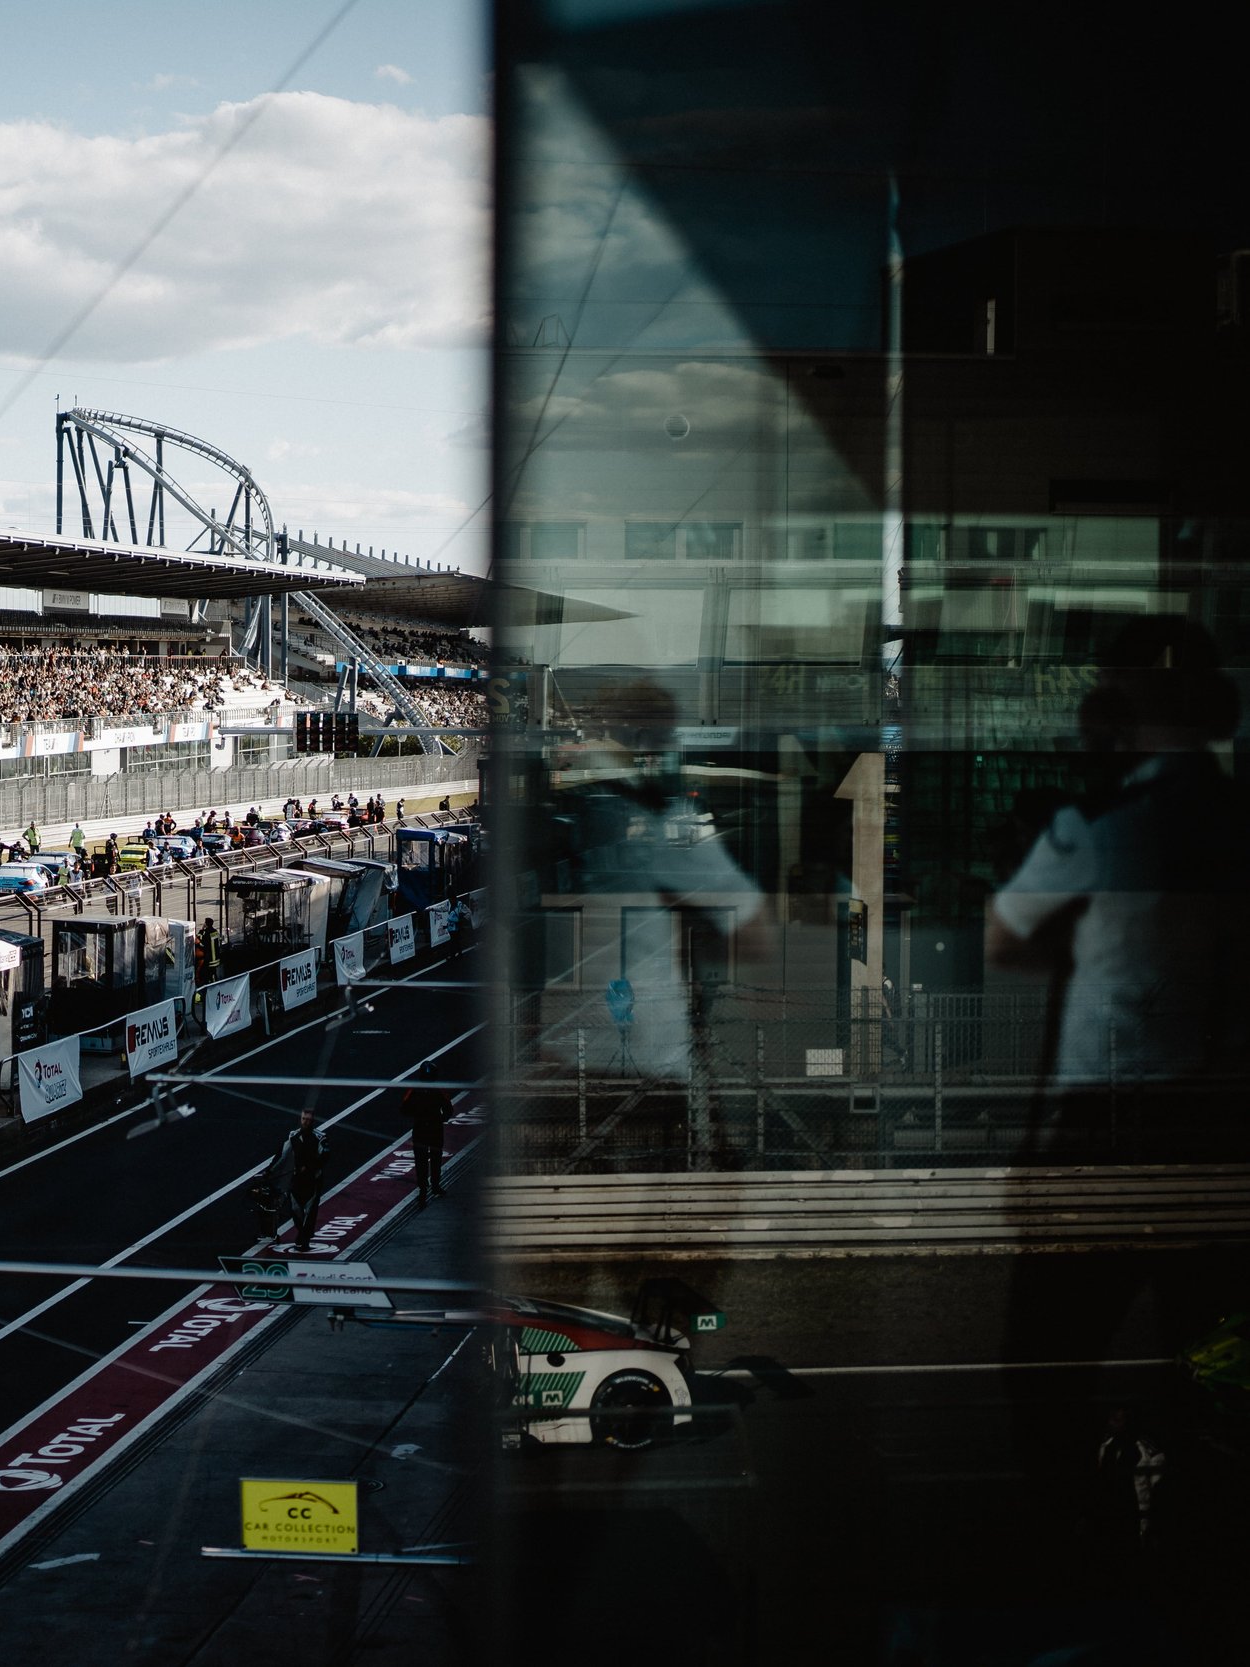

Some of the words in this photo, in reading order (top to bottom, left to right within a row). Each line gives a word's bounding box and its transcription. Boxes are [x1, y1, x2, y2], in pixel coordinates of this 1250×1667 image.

[391, 925, 410, 945] REMUS
[286, 962, 312, 988] REMUS
[221, 993, 235, 1005] TOTAL
[135, 1016, 170, 1047] REMUS
[148, 1039, 176, 1059] SPORTEXHAUST
[43, 1063, 63, 1079] TOTAL
[241, 1263, 291, 1299] 29
[9, 1412, 125, 1465] TOTAL
[287, 1507, 312, 1519] CC
[244, 1522, 269, 1531] CAR
[275, 1523, 355, 1534] COLLECTION
[261, 1535, 338, 1543] MOTORSPORT
